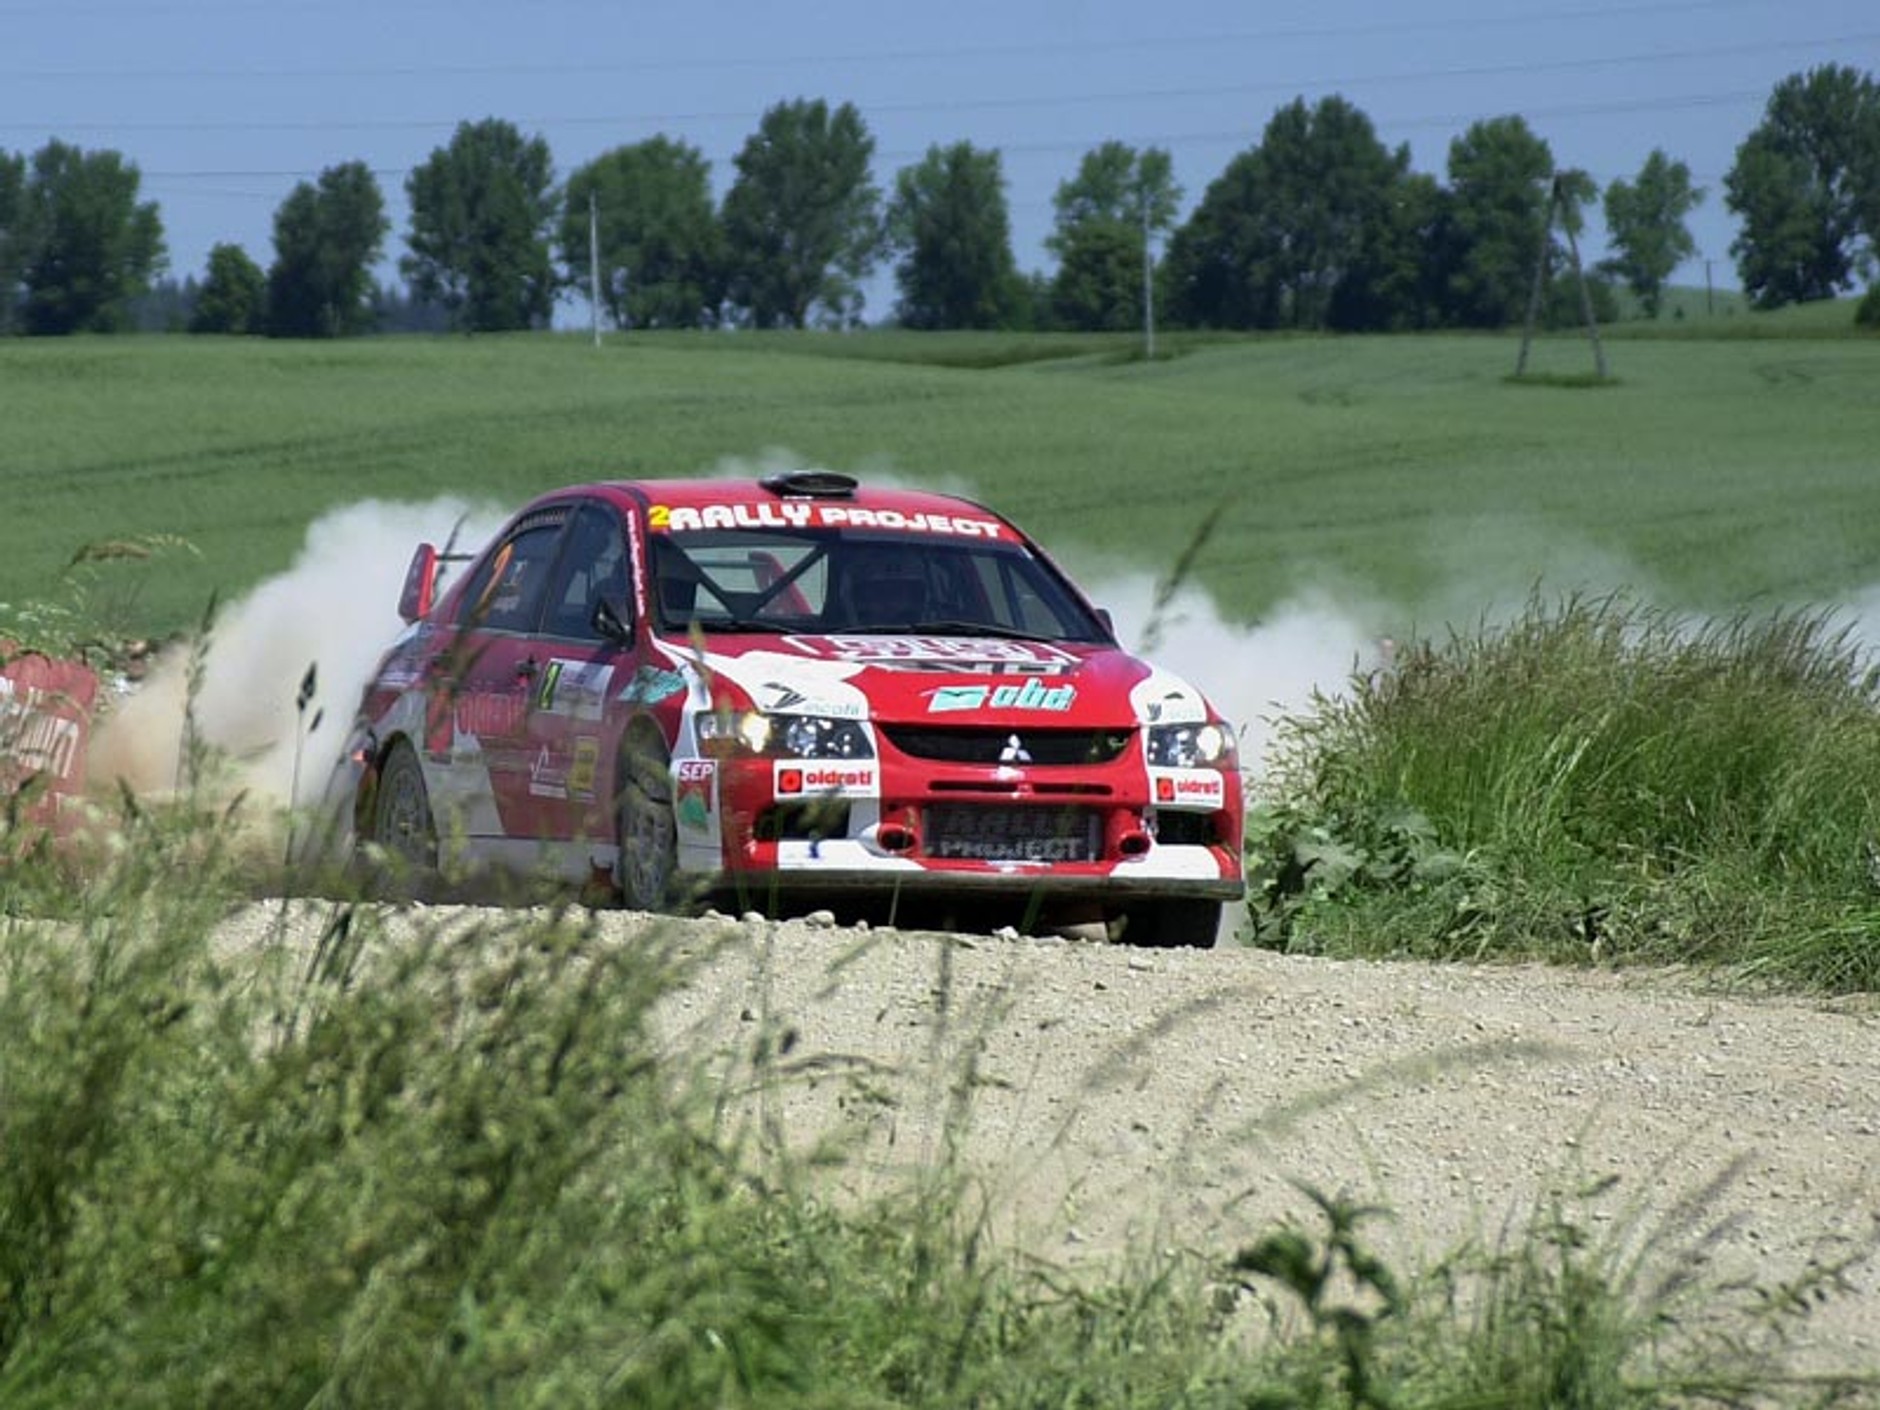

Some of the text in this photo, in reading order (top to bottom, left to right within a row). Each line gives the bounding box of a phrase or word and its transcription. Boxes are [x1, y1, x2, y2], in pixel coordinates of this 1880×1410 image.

[648, 504, 670, 527] 2
[668, 503, 1001, 538] RALLY PROJECT
[679, 763, 713, 781] SEP
